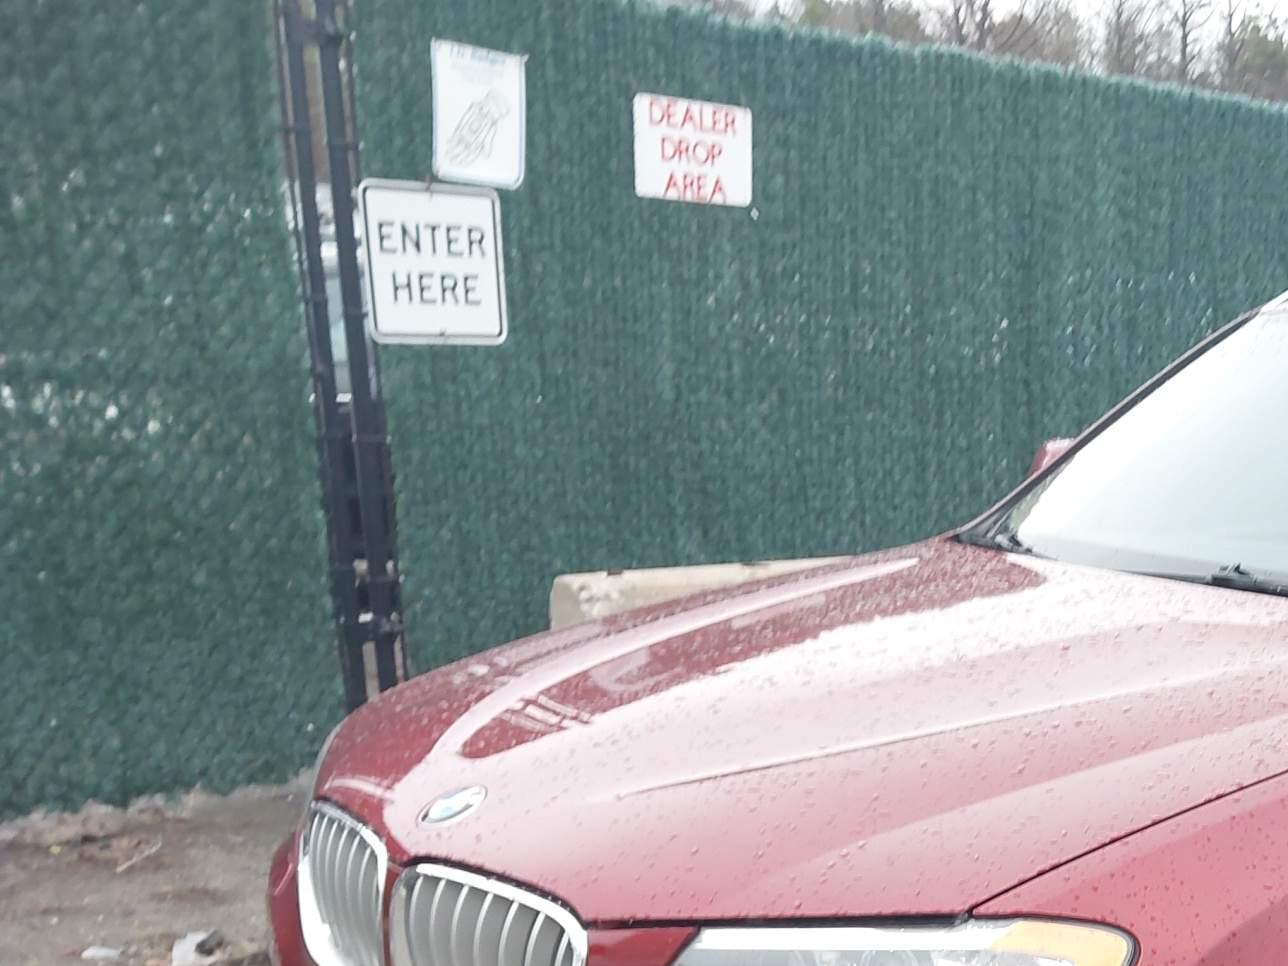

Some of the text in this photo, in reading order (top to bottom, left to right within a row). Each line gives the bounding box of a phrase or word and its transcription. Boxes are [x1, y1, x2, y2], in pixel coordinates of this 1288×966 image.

[647, 100, 738, 135] DEALER
[660, 136, 723, 168] DROP
[662, 173, 728, 203] AREA
[377, 221, 487, 260] ENTER
[391, 272, 482, 307] HERE
